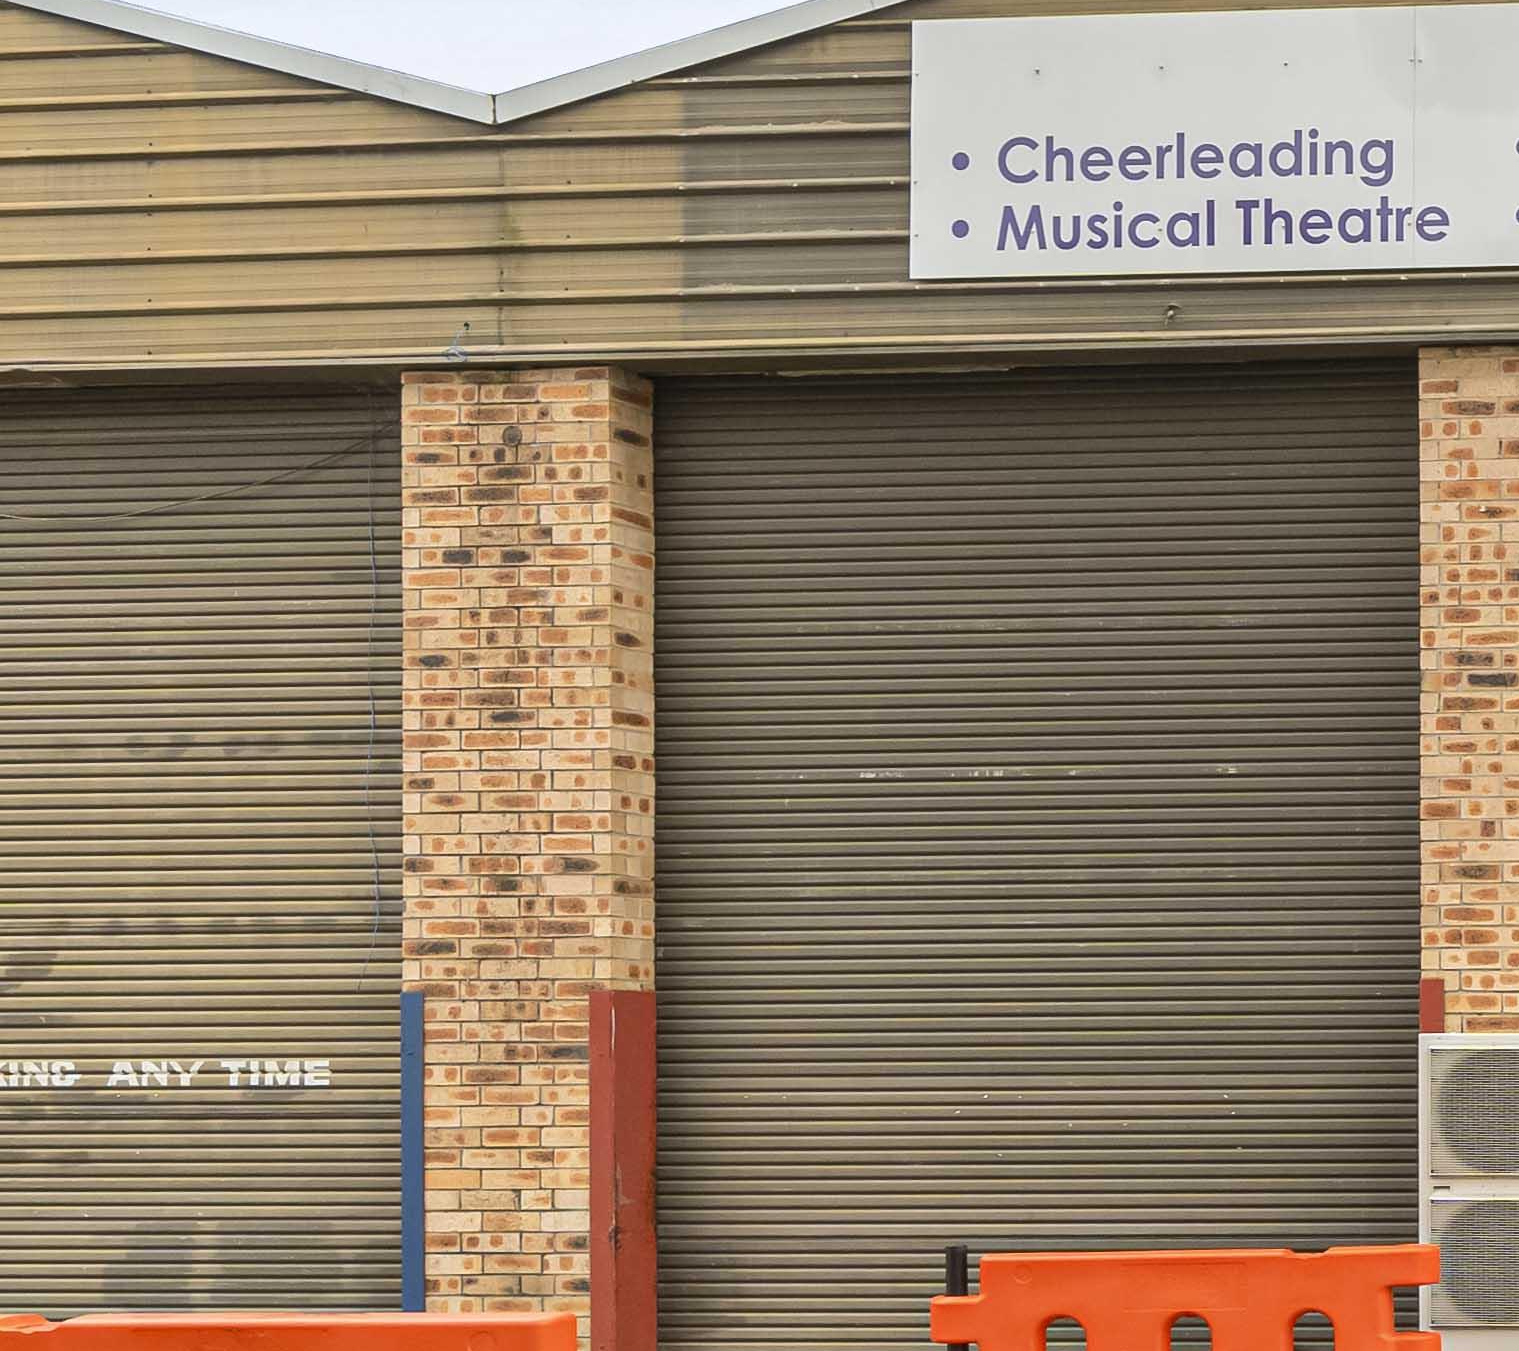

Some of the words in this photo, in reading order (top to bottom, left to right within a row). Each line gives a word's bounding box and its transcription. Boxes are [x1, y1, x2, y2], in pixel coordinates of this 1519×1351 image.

[998, 129, 1393, 187] Cheerleading
[997, 200, 1215, 250] Musical
[1237, 196, 1449, 245] Theatre
[107, 1061, 204, 1087] ANY
[221, 1059, 330, 1086] TIME
